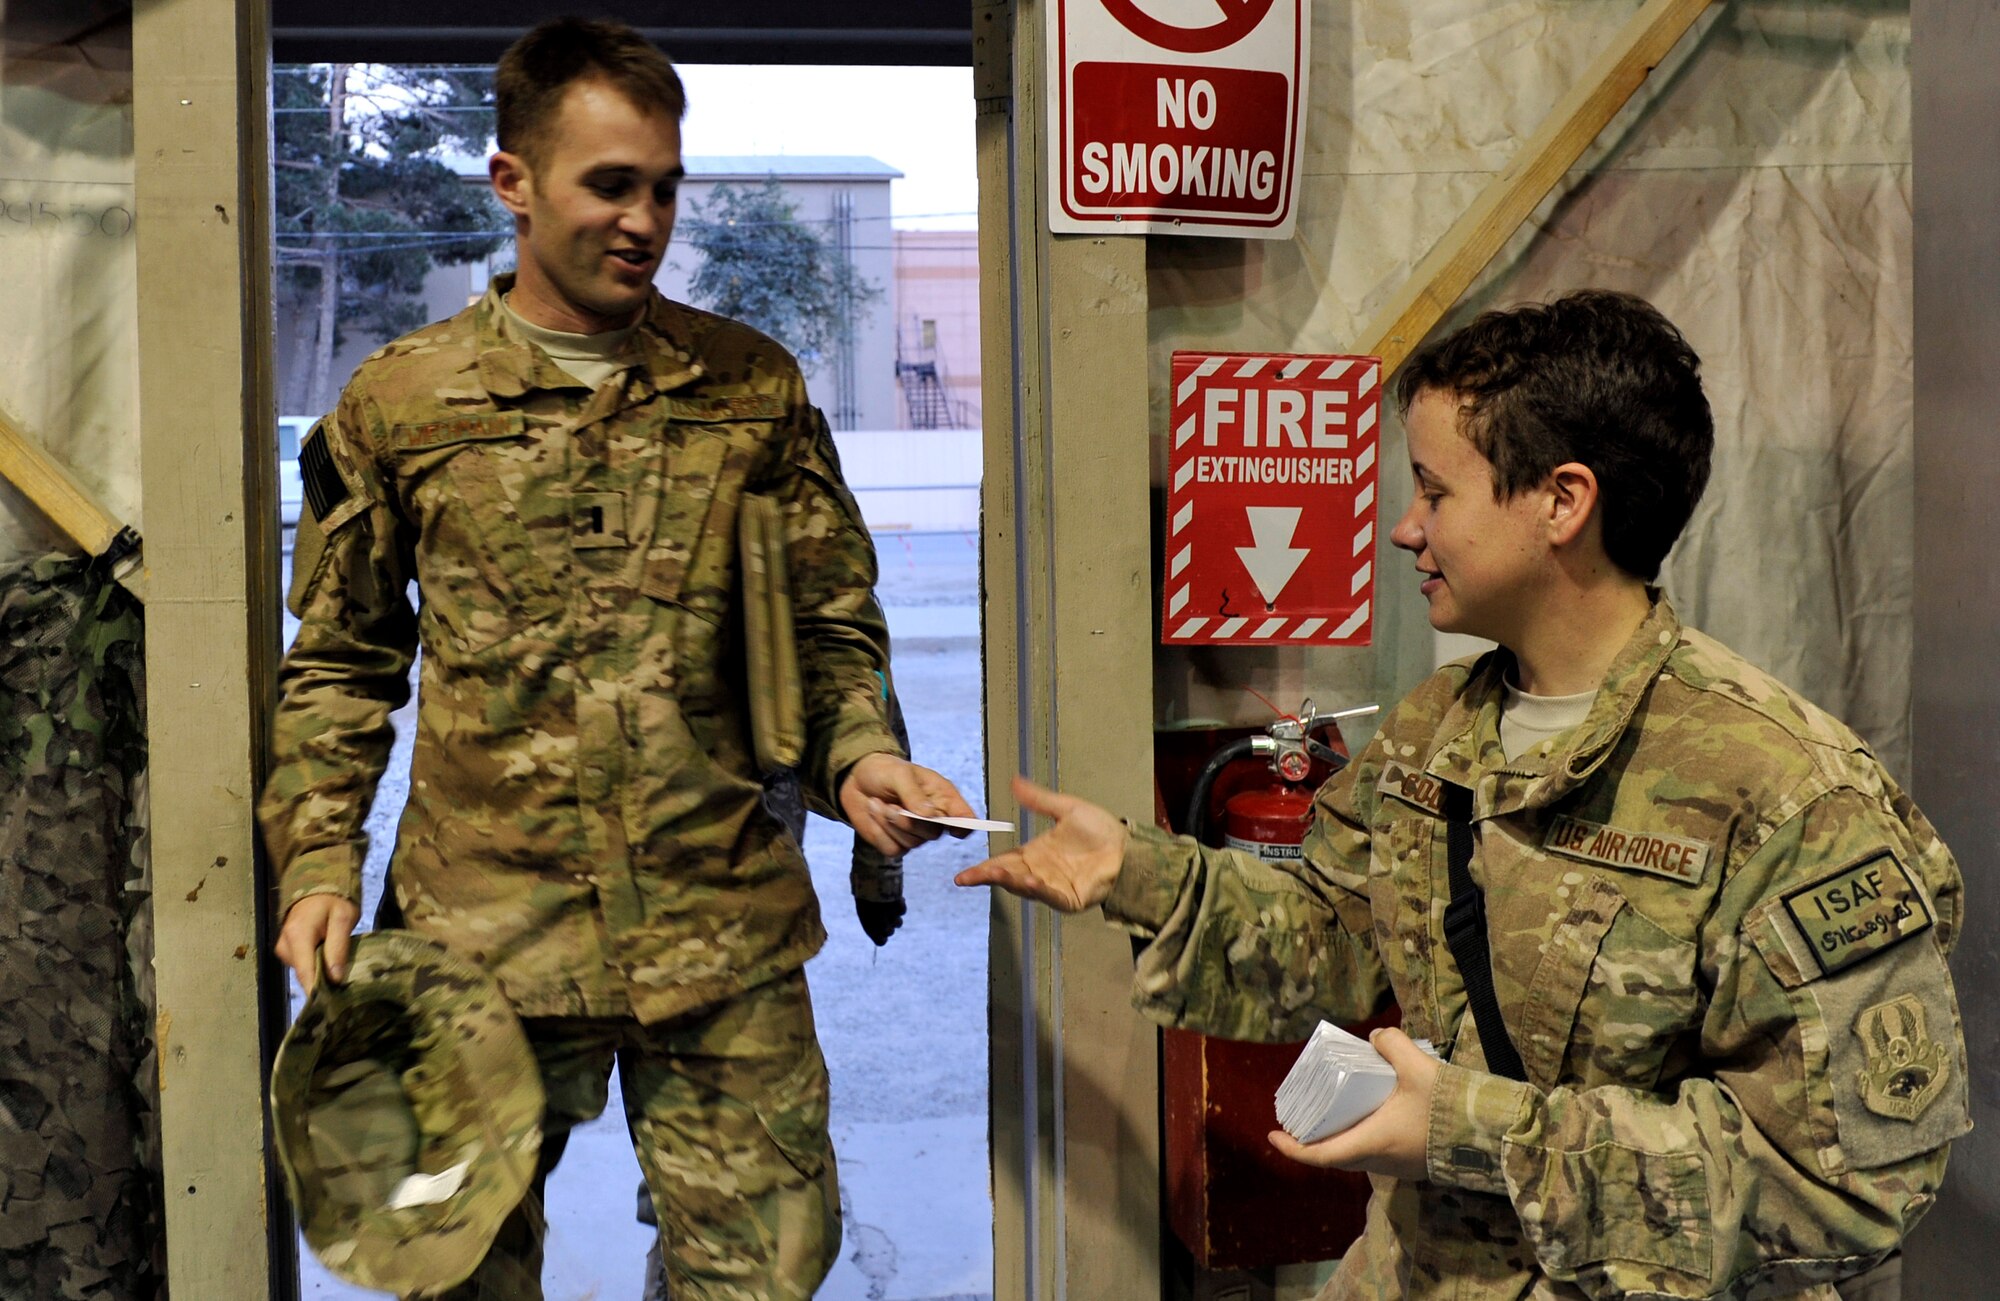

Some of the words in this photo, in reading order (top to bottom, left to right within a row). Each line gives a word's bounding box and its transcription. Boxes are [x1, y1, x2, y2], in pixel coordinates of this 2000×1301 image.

[1156, 77, 1217, 131] NO
[1081, 141, 1276, 201] SMOKING
[1203, 388, 1349, 449] FIRE
[1197, 455, 1353, 485] EXTINGUISHER
[1262, 846, 1304, 859] INSTRU
[1554, 822, 1584, 853] U.S.
[1587, 829, 1627, 863] AIR
[1623, 836, 1698, 877] FORCE
[1813, 870, 1883, 922] ISAF
